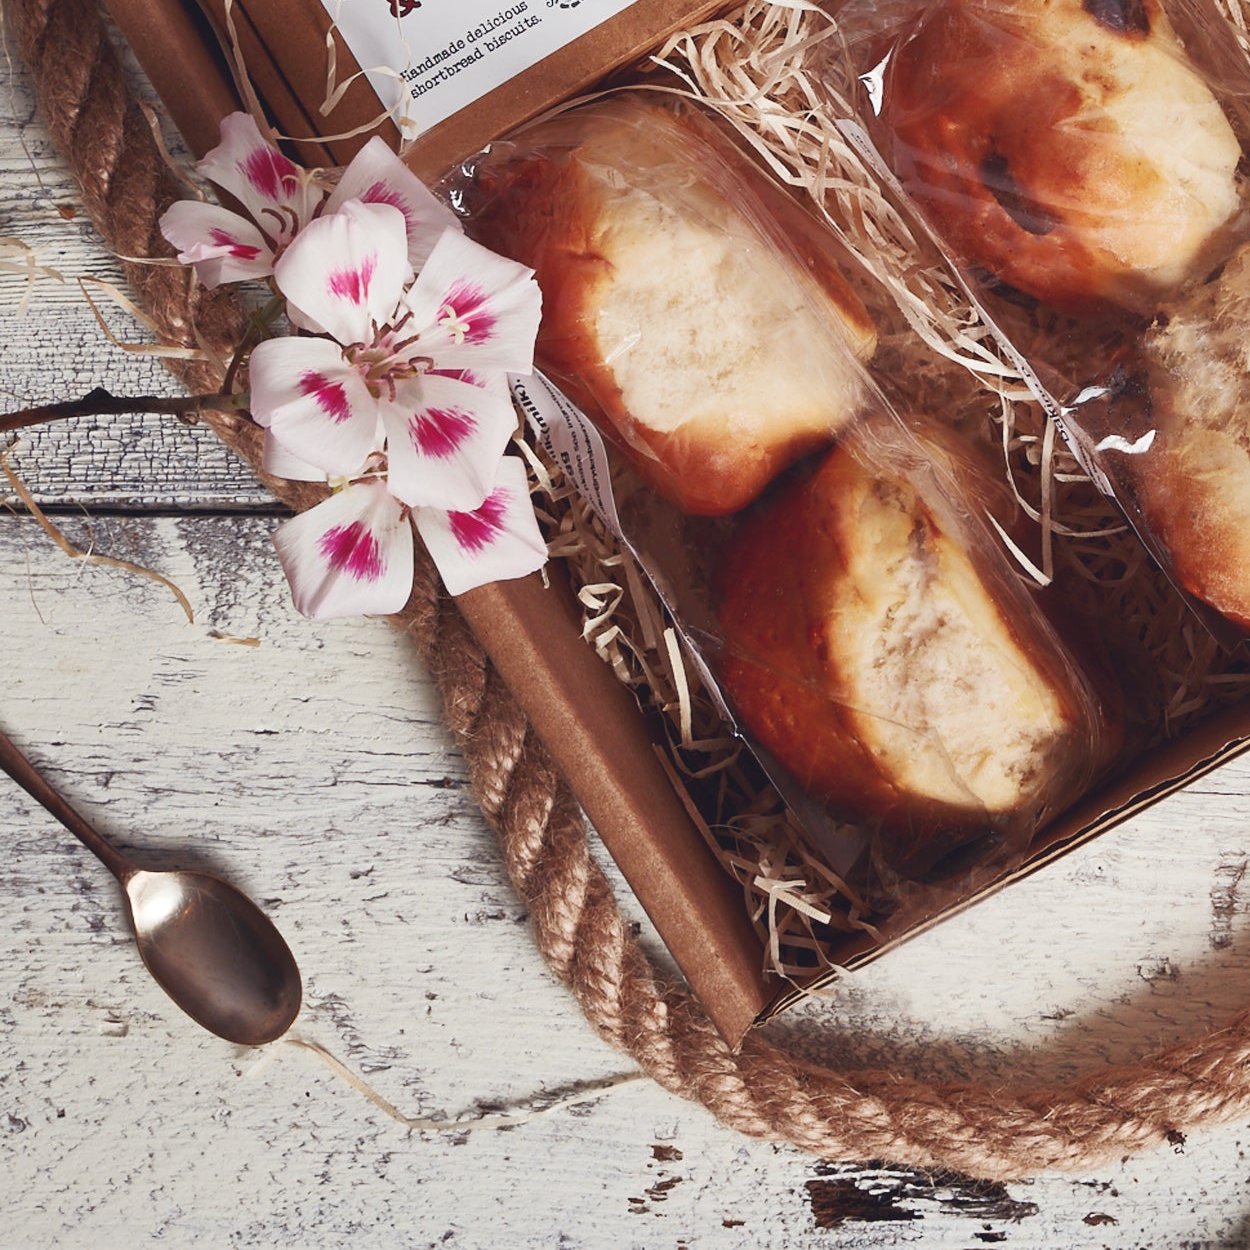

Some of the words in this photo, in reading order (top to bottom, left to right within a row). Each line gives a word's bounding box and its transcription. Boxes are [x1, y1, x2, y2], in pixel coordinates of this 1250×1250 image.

[399, 39, 466, 83] Handmade
[466, 1, 528, 44] delicious
[410, 47, 485, 99] shortbread
[483, 15, 542, 52] biscuits.
